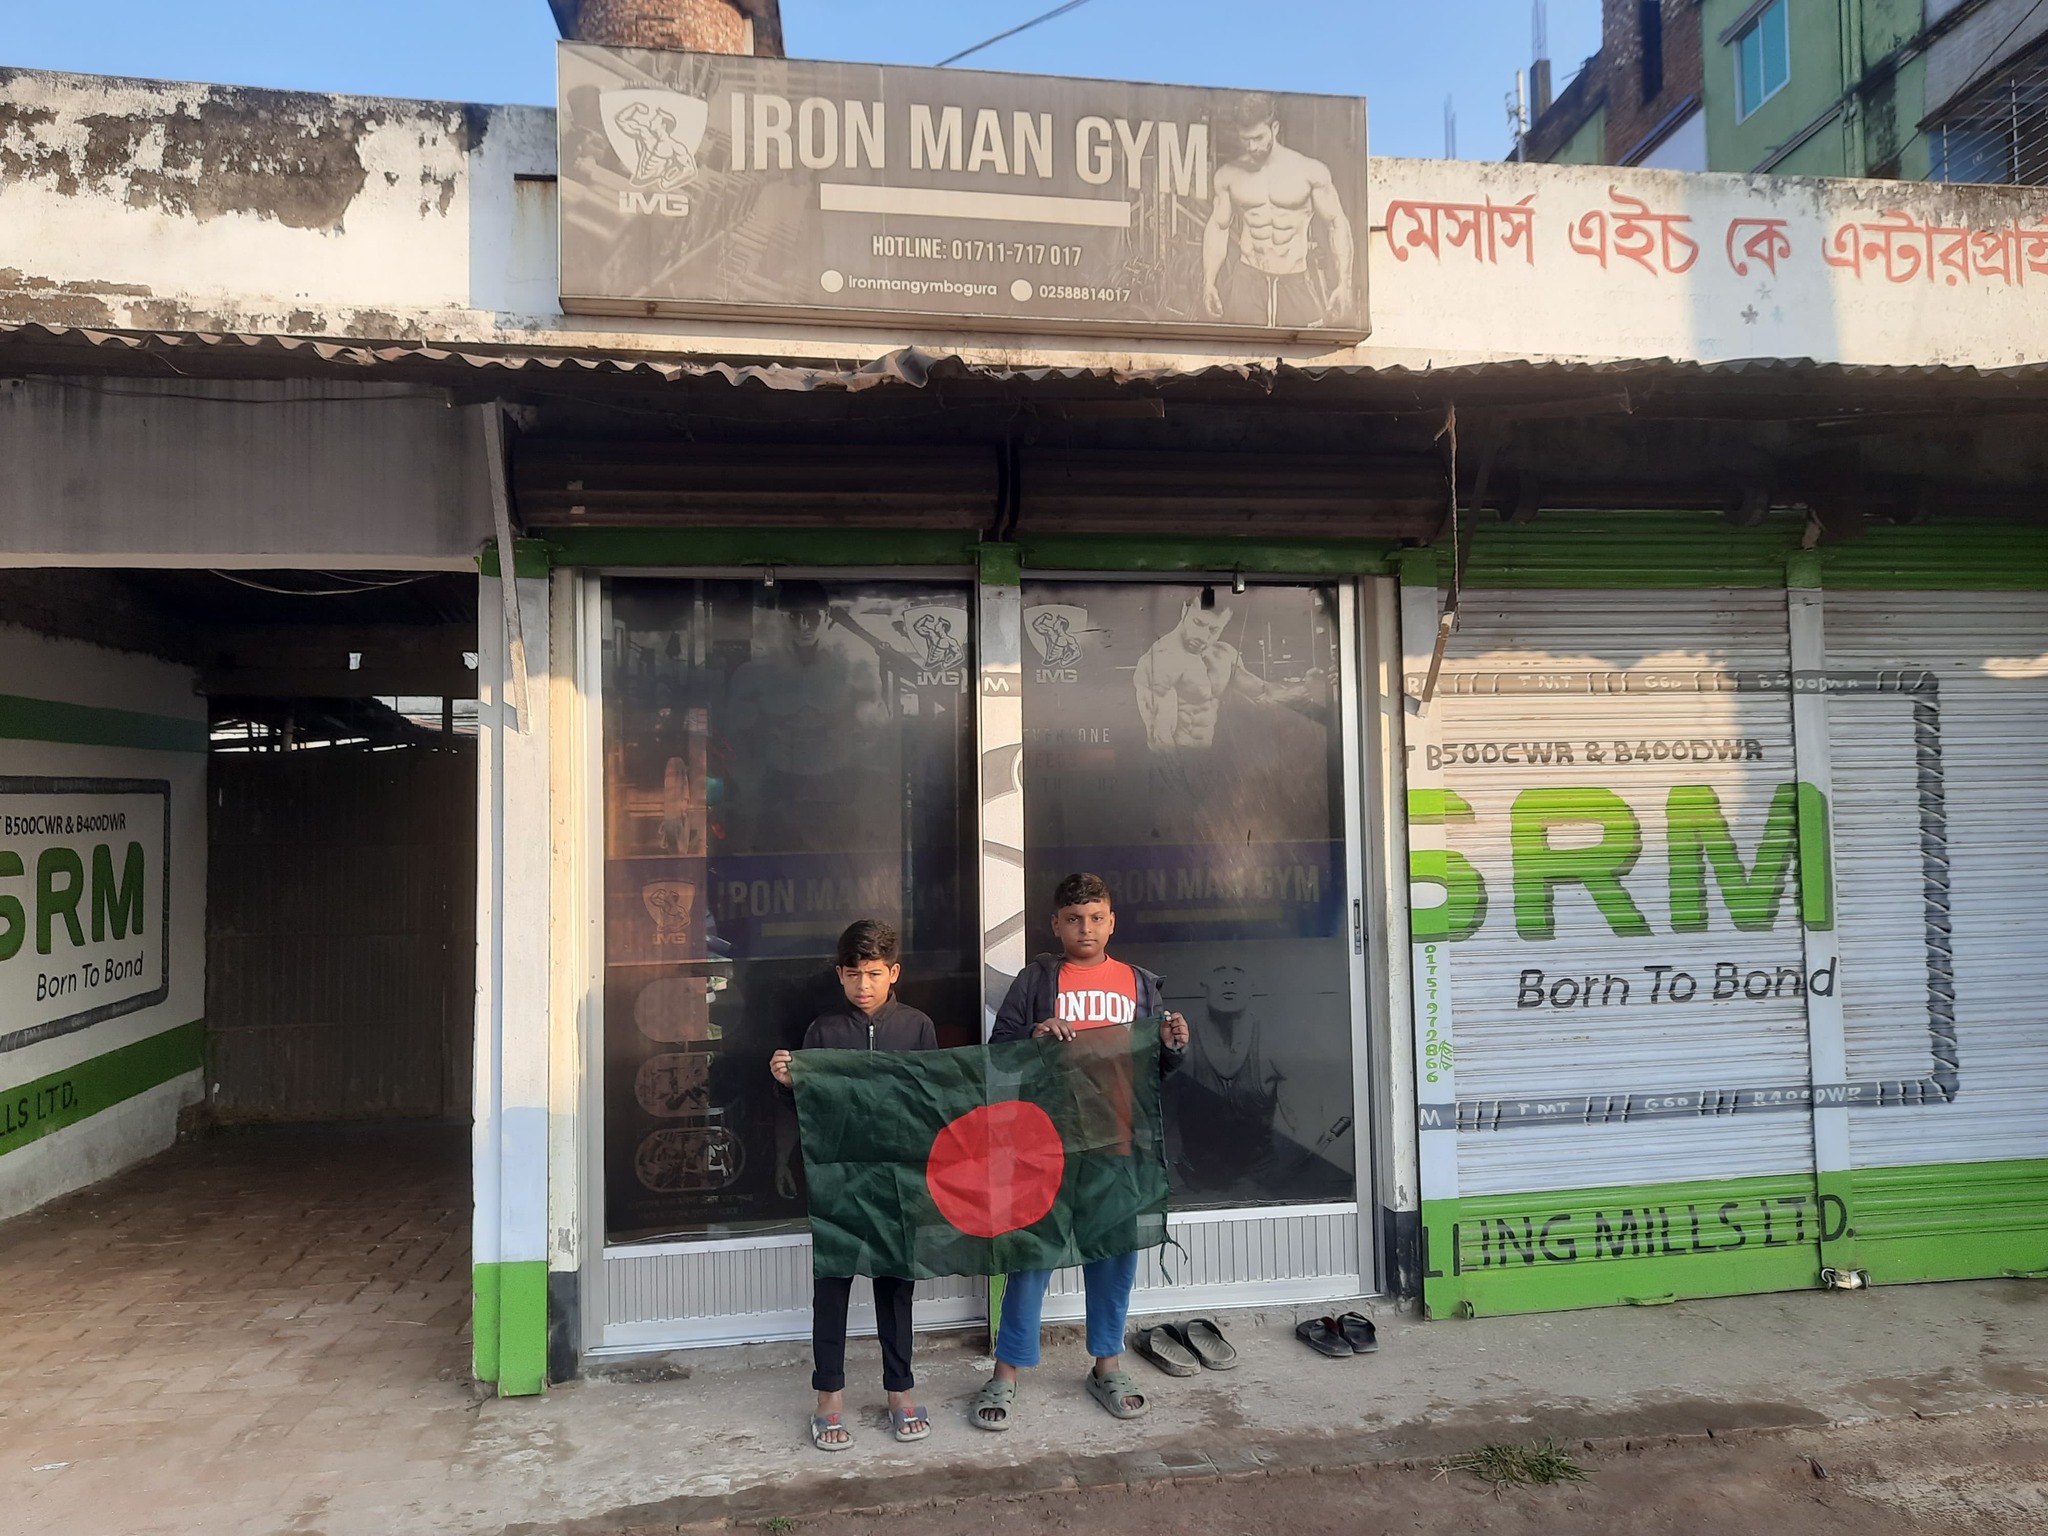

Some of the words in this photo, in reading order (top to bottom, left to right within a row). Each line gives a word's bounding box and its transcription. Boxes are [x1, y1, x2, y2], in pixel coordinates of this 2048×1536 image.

[730, 92, 887, 174] IRON
[910, 104, 1054, 179] MAN
[1074, 115, 1209, 201] GYM
[872, 235, 948, 260] HOTLINE:
[952, 241, 1045, 265] 01711-717
[1049, 245, 1082, 267] 017
[1568, 184, 1699, 276] এইচ
[1726, 216, 1792, 277] কে
[1039, 284, 1131, 303] 02588814017
[1426, 741, 1575, 771] B500CWR
[1585, 741, 1607, 763] &
[1614, 739, 1764, 763] B400DWR
[5, 815, 63, 836] B500CWR
[65, 816, 75, 834] &
[76, 812, 127, 832] B400DWR
[36, 973, 77, 1001] Born
[82, 963, 100, 988] To
[104, 950, 144, 983] Bond
[1517, 968, 1630, 1009] Born
[1644, 964, 1698, 1005] To
[1712, 956, 1837, 999] Bond
[37, 1080, 78, 1121] LTD.
[1594, 1202, 1746, 1259] MILLS
[1760, 1194, 1855, 1248] LTD.
